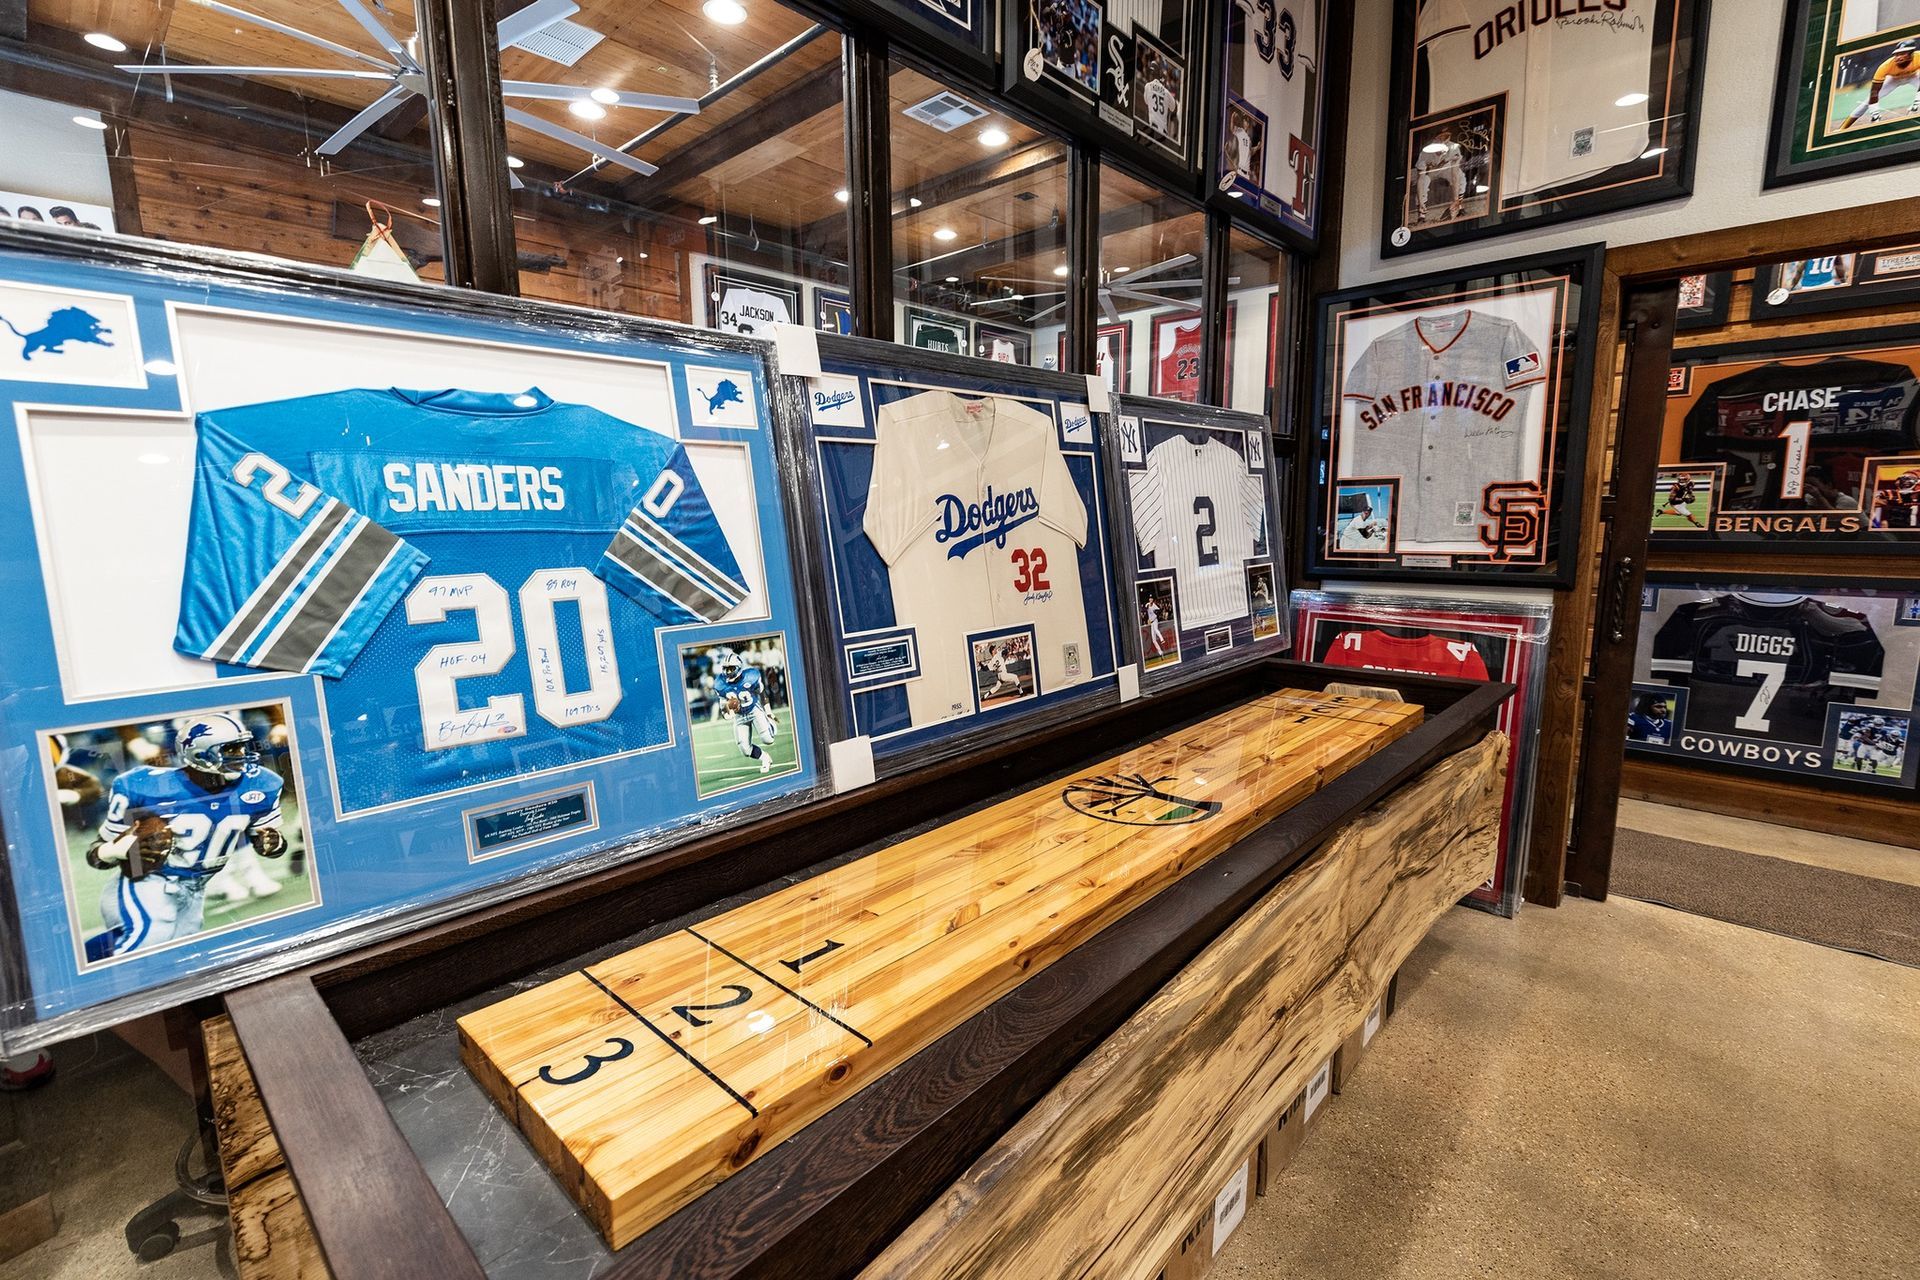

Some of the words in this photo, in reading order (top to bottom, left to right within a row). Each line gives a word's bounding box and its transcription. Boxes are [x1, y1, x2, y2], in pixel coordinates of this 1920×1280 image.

[1254, 0, 1296, 82] 33
[1106, 34, 1129, 108] Sox
[1152, 93, 1165, 115] 35
[1809, 255, 1836, 275] 10
[721, 310, 738, 327] 34
[740, 305, 775, 322] JACKSON
[927, 339, 949, 353] HURTS
[1176, 357, 1201, 381] 23
[814, 388, 857, 412] Dodgers
[1360, 393, 1399, 431] SAN
[1400, 381, 1516, 423] FRANCISCO
[1763, 386, 1842, 414] CHASE
[1064, 415, 1088, 434] Dodgers
[1778, 420, 1812, 499] 1
[232, 452, 323, 519] 2
[383, 462, 566, 513] SANDERS
[643, 469, 686, 518] 0
[935, 485, 1040, 556] Dodgers
[1193, 495, 1220, 567] 2
[1715, 516, 1861, 533] BENGALS
[1010, 547, 1051, 593] 32
[449, 585, 474, 598] MVP
[404, 567, 623, 752] 20
[1735, 633, 1796, 657] DIGGS
[1312, 704, 1340, 715] 2
[1735, 659, 1787, 733] 7
[1680, 735, 1823, 769] COWBOYS
[167, 813, 251, 869] 20
[778, 939, 846, 974] 1
[671, 984, 753, 1027] 2
[538, 1037, 635, 1086] 3
